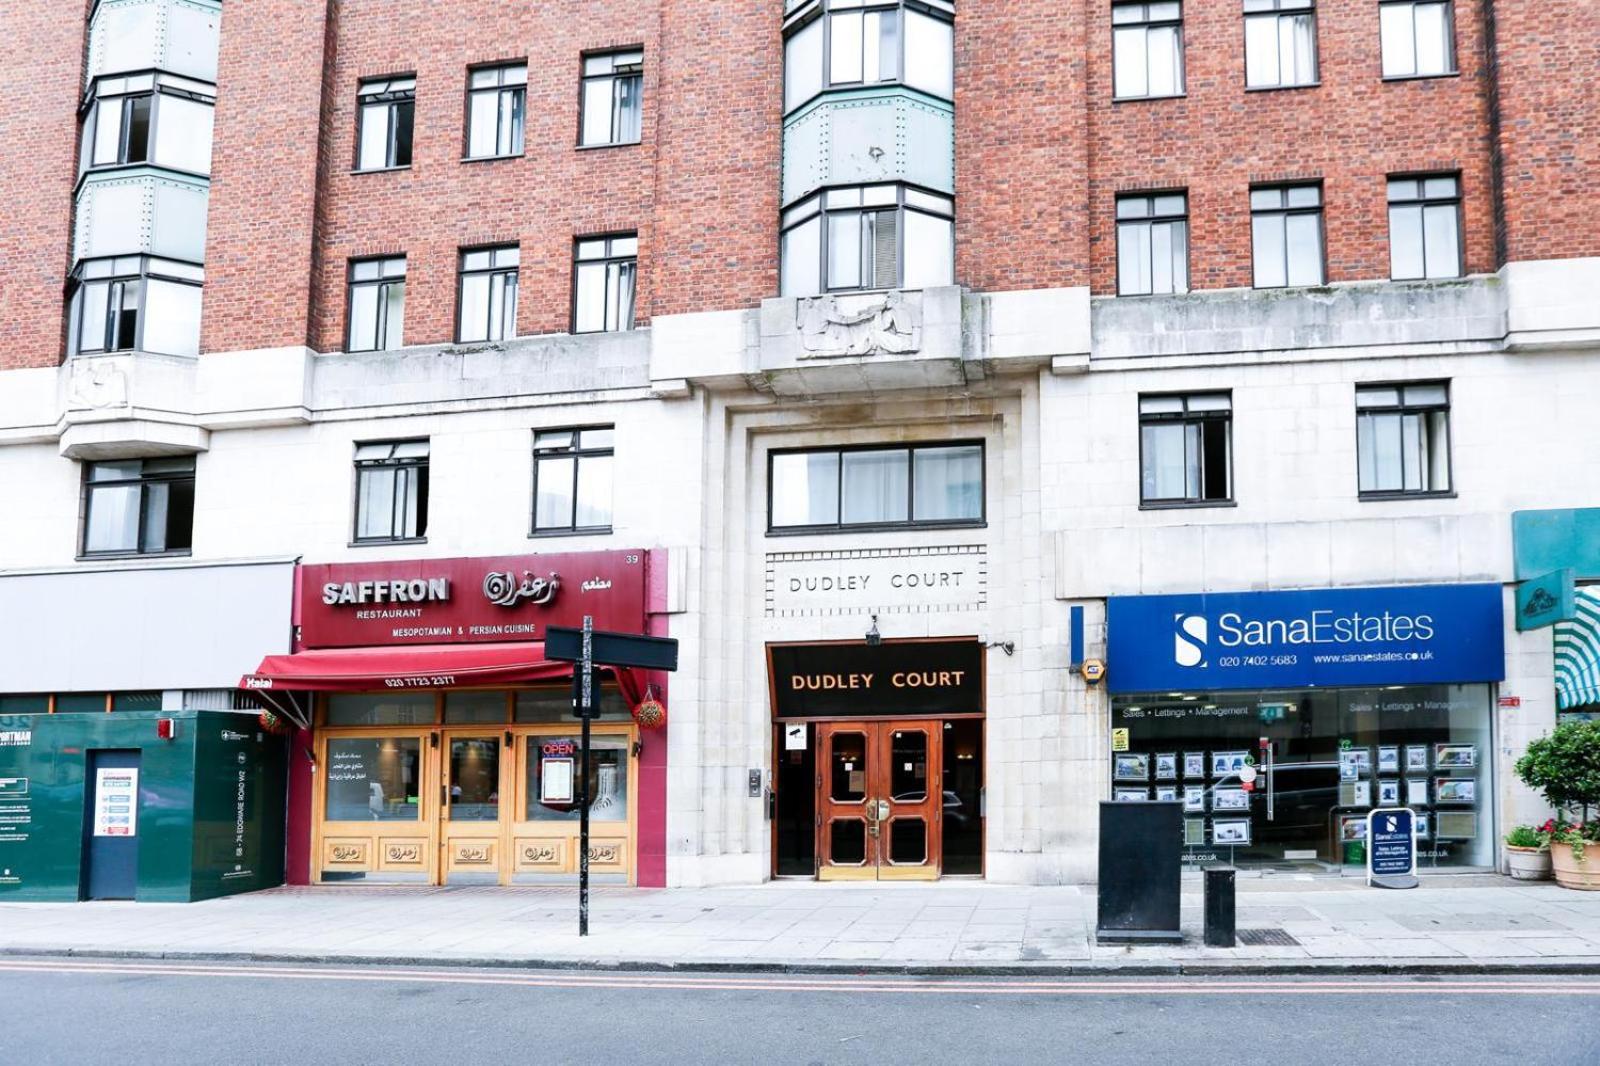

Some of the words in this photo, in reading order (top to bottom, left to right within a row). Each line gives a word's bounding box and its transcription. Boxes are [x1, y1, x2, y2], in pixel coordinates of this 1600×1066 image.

[626, 555, 639, 564] 39
[484, 570, 560, 605] زعفران
[581, 575, 612, 593] مطعم
[789, 575, 871, 592] DUDLEY
[890, 571, 964, 588] COURT
[322, 578, 448, 605] SAFFRON
[356, 608, 423, 620] RESTAURANT
[392, 626, 452, 637] MESOPOTAMIAN
[457, 625, 464, 636] &
[469, 624, 503, 635] PERSIAN
[504, 623, 536, 634] CUISINE
[1219, 610, 1434, 646] SanaEstates
[1219, 656, 1240, 667] 020
[1242, 655, 1269, 666] 7402
[1270, 654, 1298, 666] 5683
[1313, 650, 1434, 664] www.sanaestates.co.uk
[384, 678, 404, 687] 020
[406, 677, 431, 687] 7723
[431, 675, 456, 685] 2377
[791, 673, 875, 690] DUDLEY
[891, 671, 965, 688] COURT
[1154, 706, 1186, 718] Lettings
[1381, 701, 1416, 713] Lettings
[543, 744, 574, 755] OPEN
[1180, 853, 1217, 862] ates.co.uk
